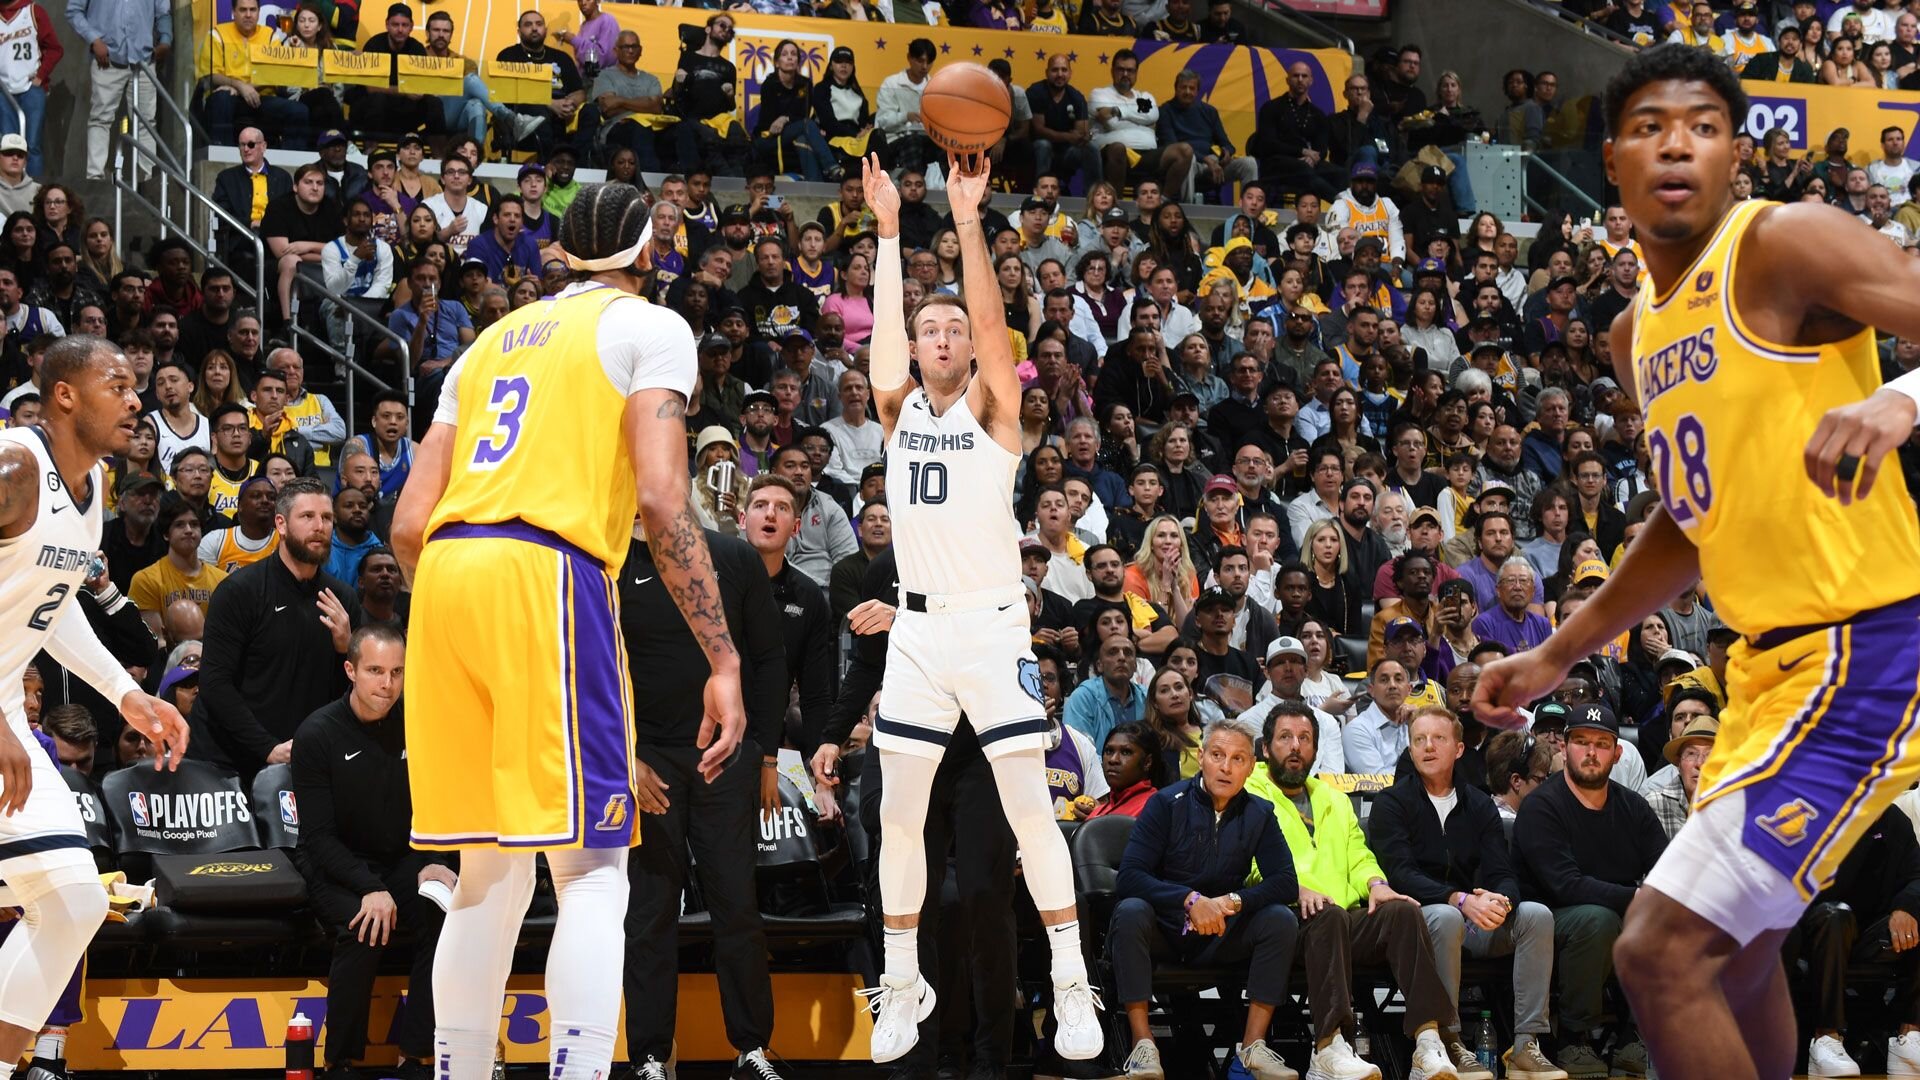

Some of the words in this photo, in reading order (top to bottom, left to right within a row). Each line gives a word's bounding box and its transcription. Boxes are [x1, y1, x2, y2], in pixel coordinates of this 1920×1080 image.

[13, 42, 32, 61] 23
[1737, 103, 1799, 142] 02
[928, 126, 986, 150] Wilson
[1688, 292, 1719, 311] bibigo
[470, 375, 532, 468] 3
[899, 430, 975, 453] MEMHIS
[1648, 412, 1714, 523] 28
[47, 472, 60, 492] 6
[908, 461, 948, 505] 10
[27, 582, 70, 631] 2
[150, 791, 251, 829] PLAYOFFS
[162, 830, 195, 842] Google
[197, 829, 218, 839] Pixel
[757, 842, 778, 852] Pixel
